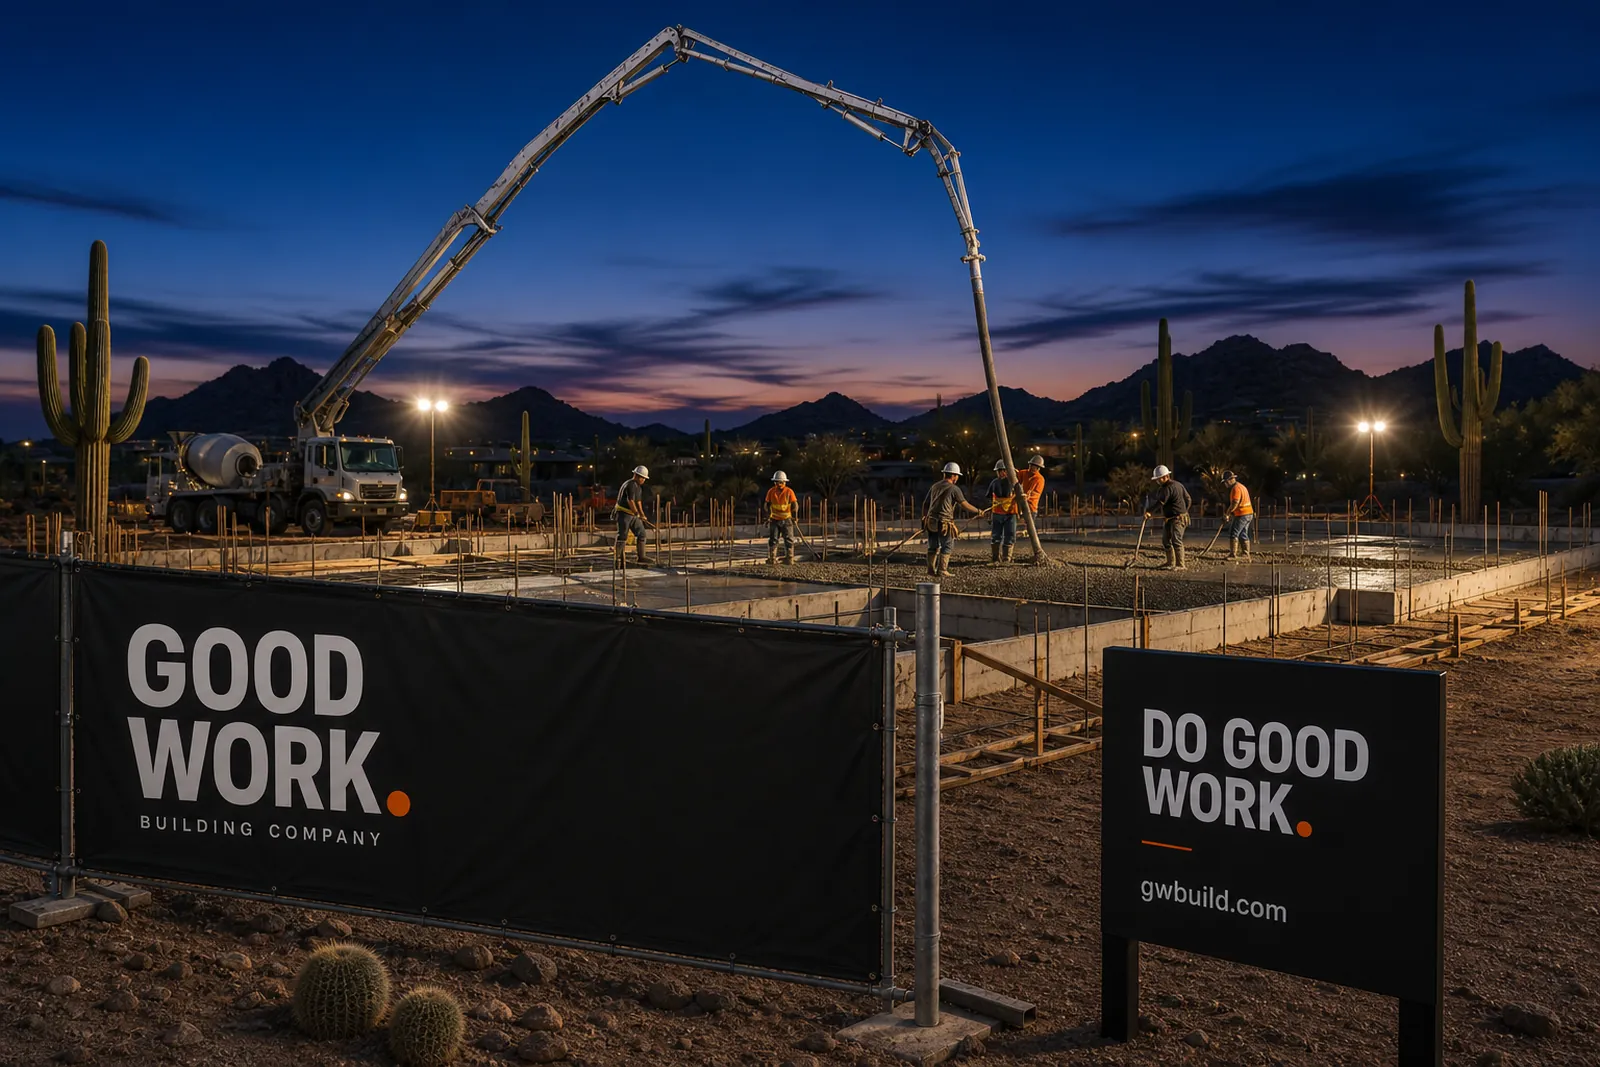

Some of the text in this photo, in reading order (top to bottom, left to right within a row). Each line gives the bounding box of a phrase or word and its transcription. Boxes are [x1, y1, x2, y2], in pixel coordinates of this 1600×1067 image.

[127, 623, 364, 716] GOOD
[127, 716, 411, 818] WORK.
[1143, 708, 1370, 782] DO GOOD
[140, 814, 381, 847] BUILDING COMPANY
[1142, 765, 1313, 838] WORK.
[1140, 879, 1287, 923] gwbuild.com
